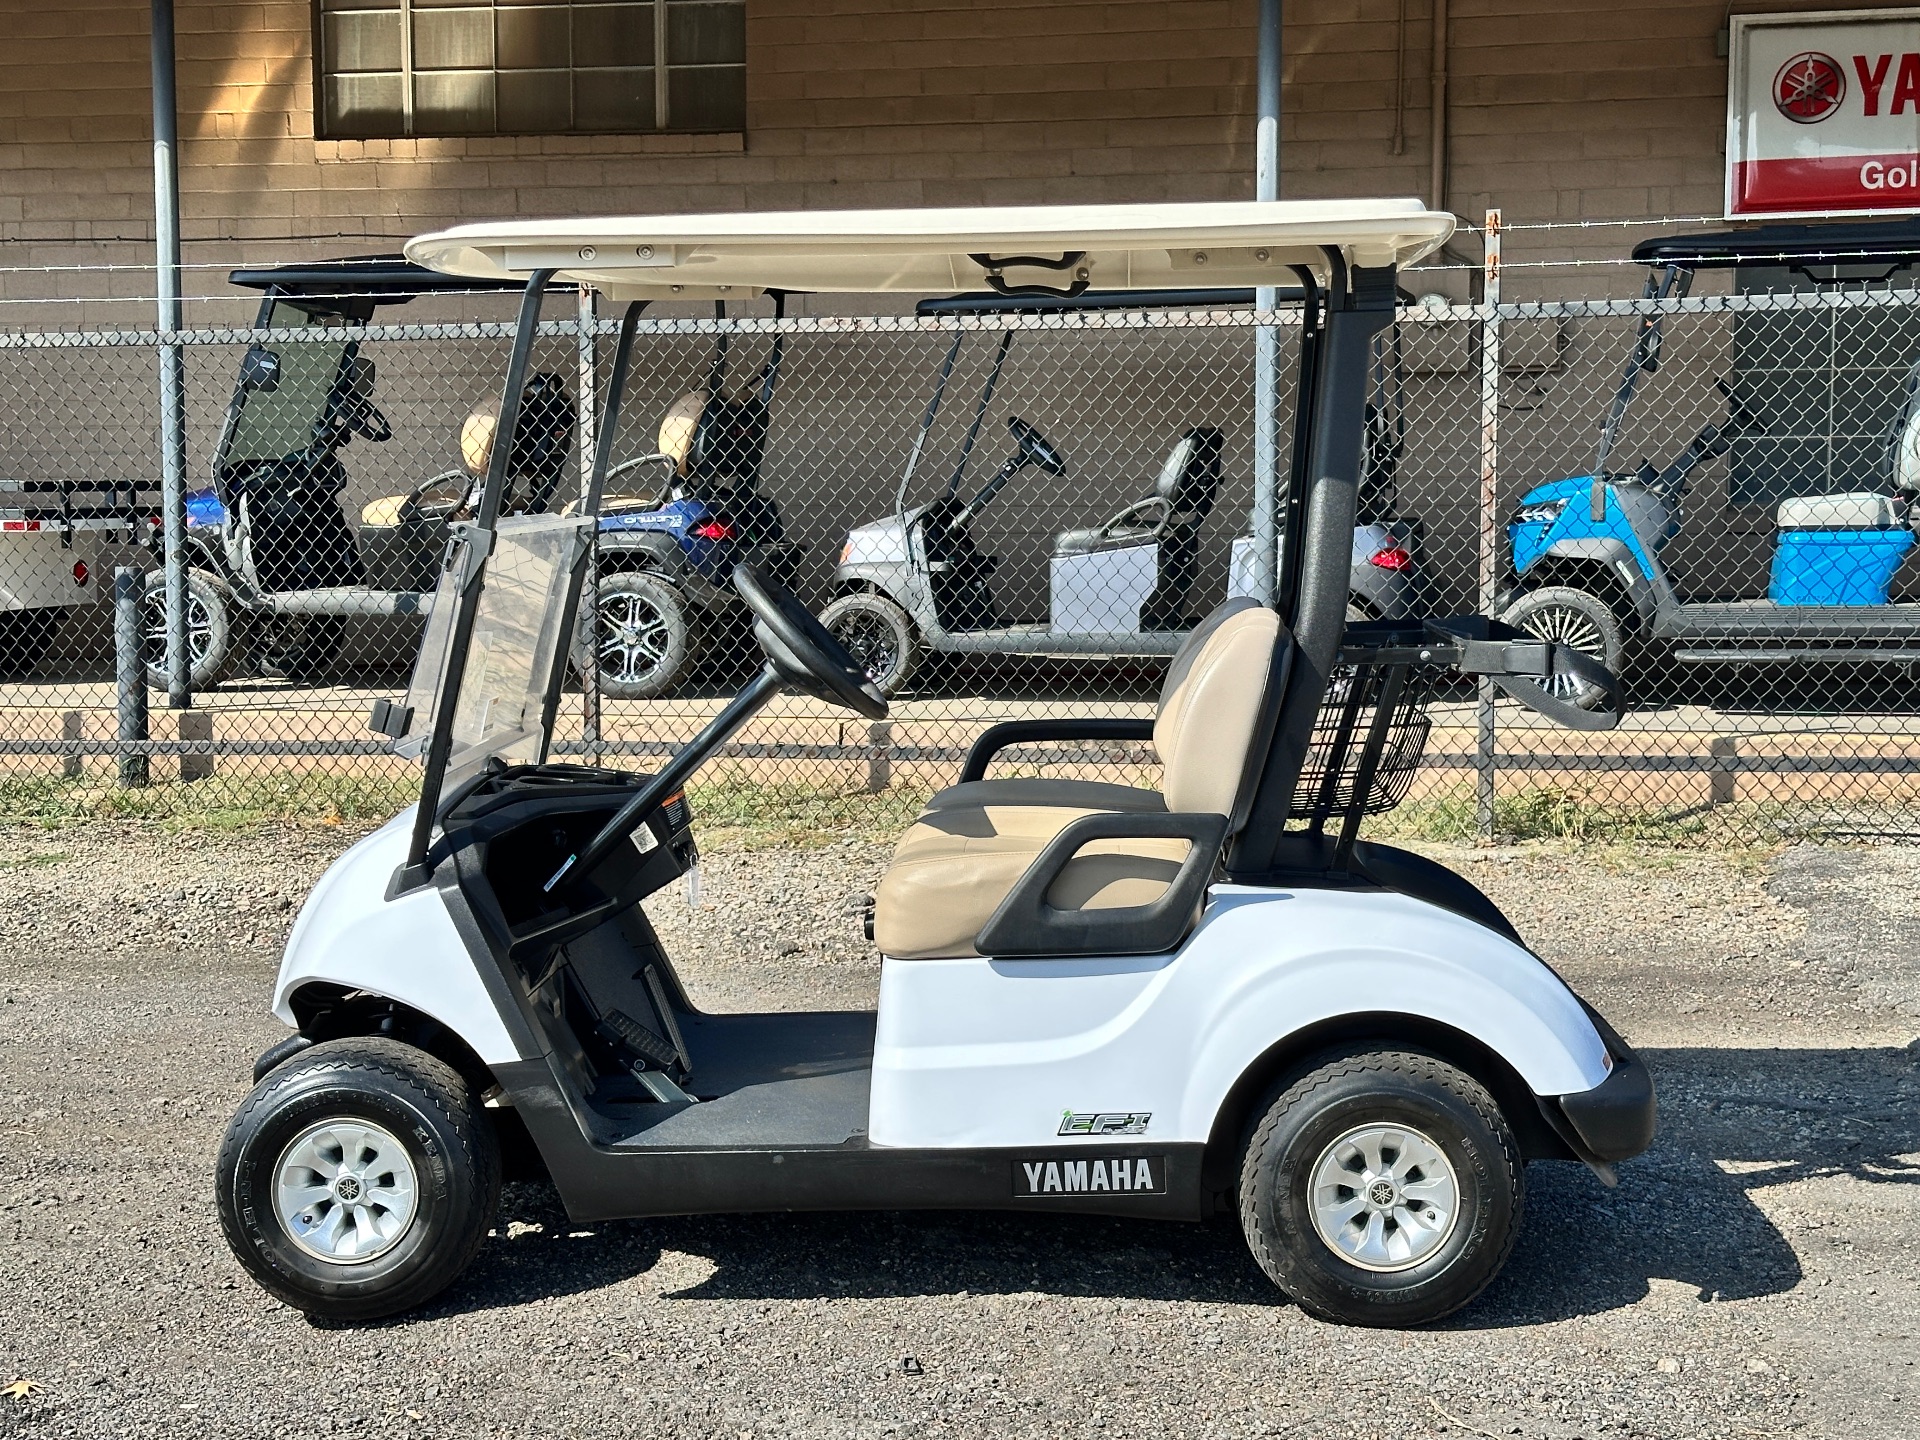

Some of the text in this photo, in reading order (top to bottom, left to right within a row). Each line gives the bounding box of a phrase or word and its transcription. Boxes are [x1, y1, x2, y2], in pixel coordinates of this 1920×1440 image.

[1860, 159, 1920, 190] Gol
[1058, 1110, 1150, 1136] EFI
[412, 1123, 448, 1201] KENDA
[1022, 1158, 1154, 1193] YAMAHA
